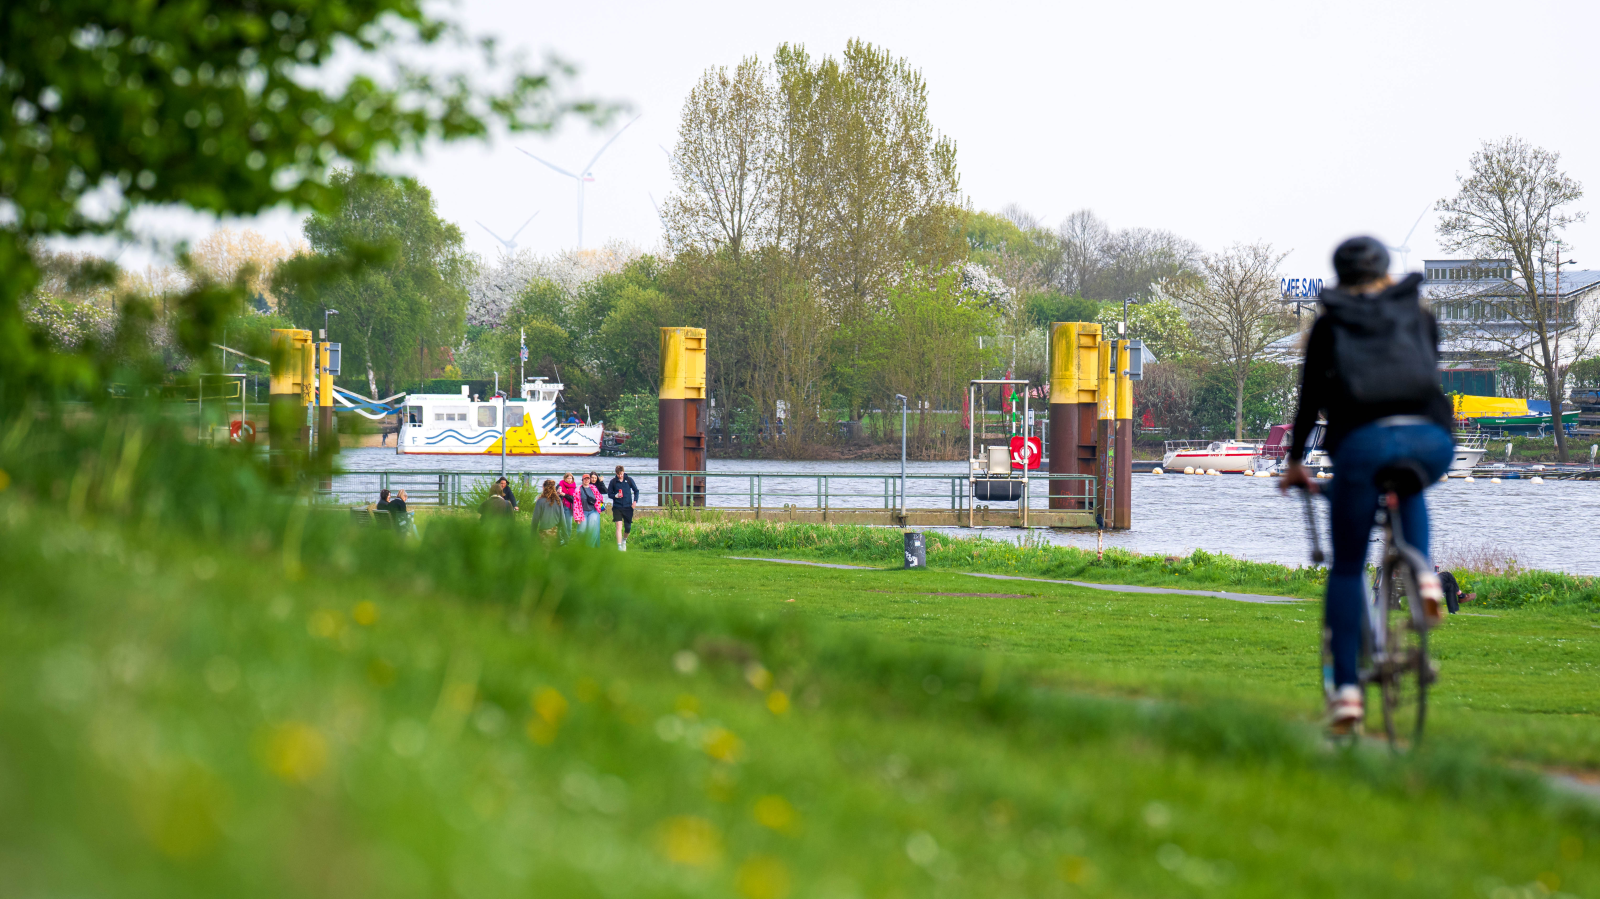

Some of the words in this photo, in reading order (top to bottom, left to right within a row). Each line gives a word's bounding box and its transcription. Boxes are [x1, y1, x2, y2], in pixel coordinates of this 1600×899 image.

[1281, 277, 1300, 297] CAFE
[1302, 277, 1324, 297] SAND
[412, 436, 418, 445] F
